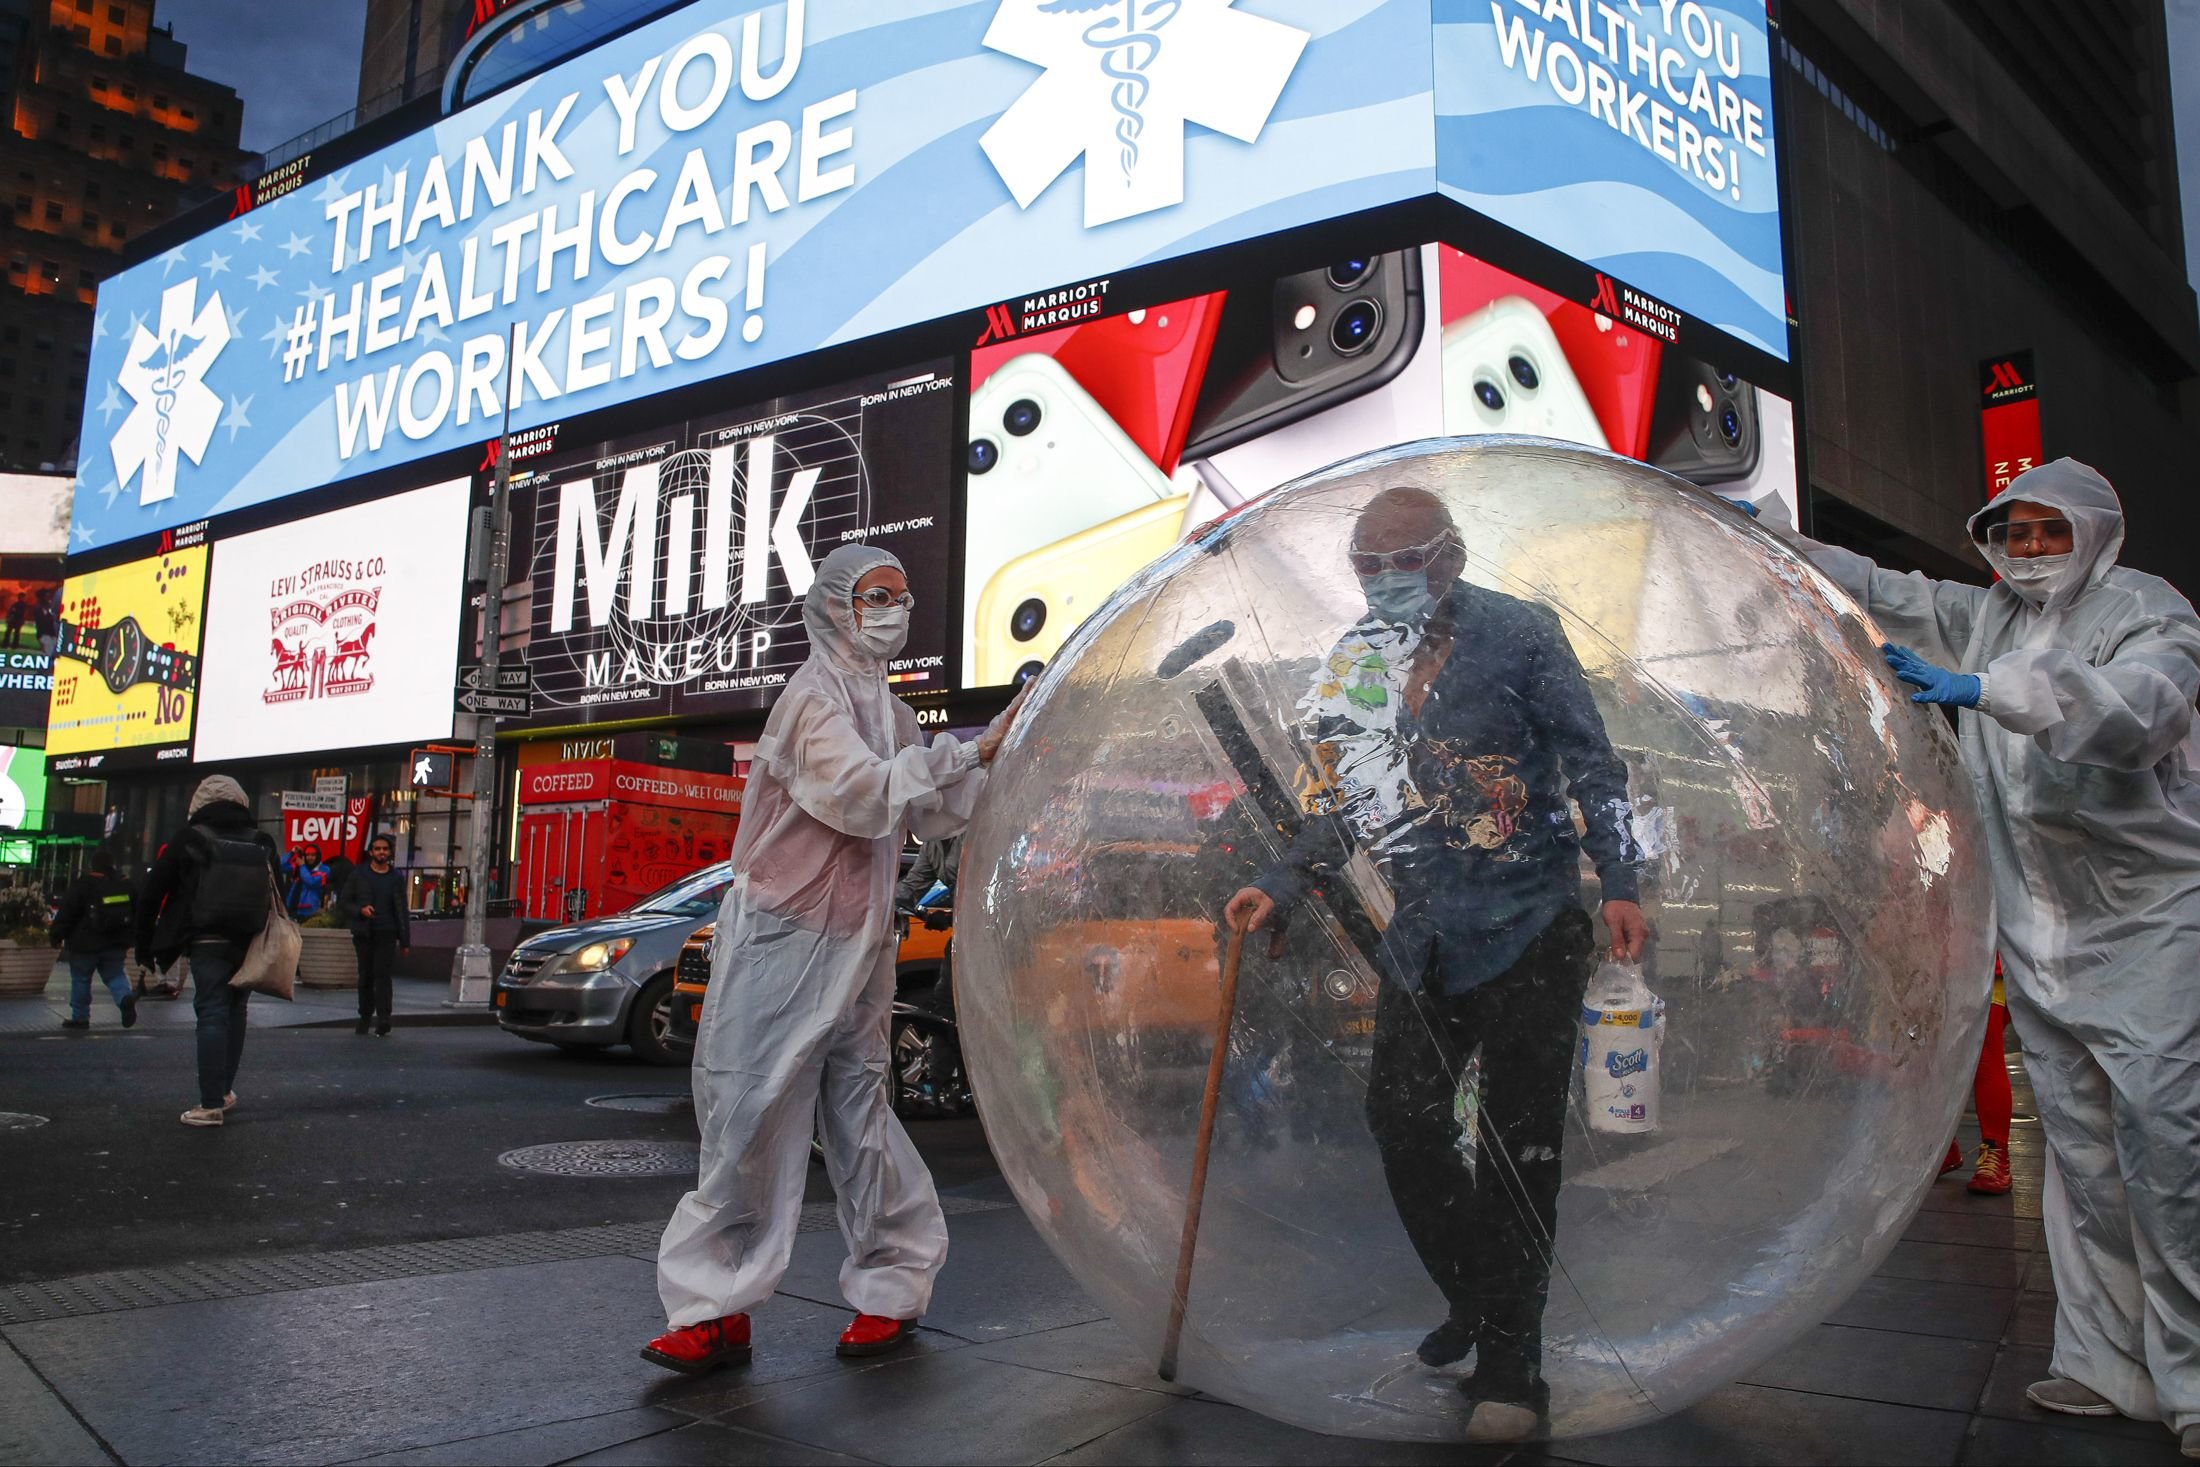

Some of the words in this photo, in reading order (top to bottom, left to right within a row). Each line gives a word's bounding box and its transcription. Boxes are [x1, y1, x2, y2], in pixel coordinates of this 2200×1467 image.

[1490, 1, 1740, 201] WORKERS!
[325, 92, 580, 273] THANK
[603, 0, 804, 156] YOU
[258, 155, 311, 190] MARRIOTT
[257, 174, 304, 206] MARQUIS
[283, 89, 857, 384] #HEALTHCARE
[1024, 280, 1110, 313] MARRIOTT
[1624, 288, 1681, 327] MARRIOTT
[1023, 300, 1099, 330] MARQUIS
[1624, 306, 1676, 341] MARQUIS
[334, 241, 767, 460] WORKERS!
[860, 391, 887, 407] BORN
[888, 389, 899, 401] IN
[900, 384, 924, 399] NEW
[923, 376, 953, 392] YORK
[1992, 384, 2035, 399] MARRIOTT
[509, 424, 560, 447] MARRIOTT
[718, 428, 743, 441] BORN
[743, 426, 753, 435] IN
[753, 421, 774, 433] NEW
[772, 413, 799, 427] YORK
[508, 439, 553, 460] MARQUIS
[596, 457, 618, 470] BORN
[617, 455, 626, 465] IN
[626, 450, 646, 463] NEW
[644, 445, 666, 458] YORK
[550, 435, 823, 634] Milk
[840, 528, 868, 542] BORN
[868, 526, 881, 537] IN
[881, 521, 905, 535] NEW
[904, 516, 933, 531] YORK
[271, 575, 297, 599] LEVI
[300, 559, 353, 590] STRAUSS
[355, 561, 364, 580] &
[366, 557, 386, 578] CO.
[273, 603, 323, 628] ORIGINAL
[325, 592, 377, 617] RIVETED
[332, 614, 363, 629] CLOTHING
[284, 624, 309, 639] QUALITY
[10, 654, 50, 669] CAN
[585, 631, 772, 688] MAKEUP
[889, 659, 914, 671] NEW
[914, 655, 944, 669] YORK
[500, 673, 522, 684] WAY
[704, 679, 729, 691] BORN
[729, 677, 739, 688] IN
[739, 675, 762, 687] NEW
[761, 673, 786, 685] YORK
[154, 685, 185, 726] No
[466, 696, 488, 708] ONE
[498, 698, 521, 709] WAY
[580, 693, 601, 705] BORN
[600, 691, 610, 702] IN
[609, 690, 630, 702] NEW
[628, 688, 651, 700] YORK
[561, 738, 616, 762] INVICT
[533, 773, 594, 793] COFFEED
[616, 774, 679, 796] COFFEED
[685, 785, 711, 800] SWEET
[1612, 1049, 1642, 1071] Scott
[1608, 1105, 1615, 1114] 4
[1634, 1107, 1641, 1115] 4
